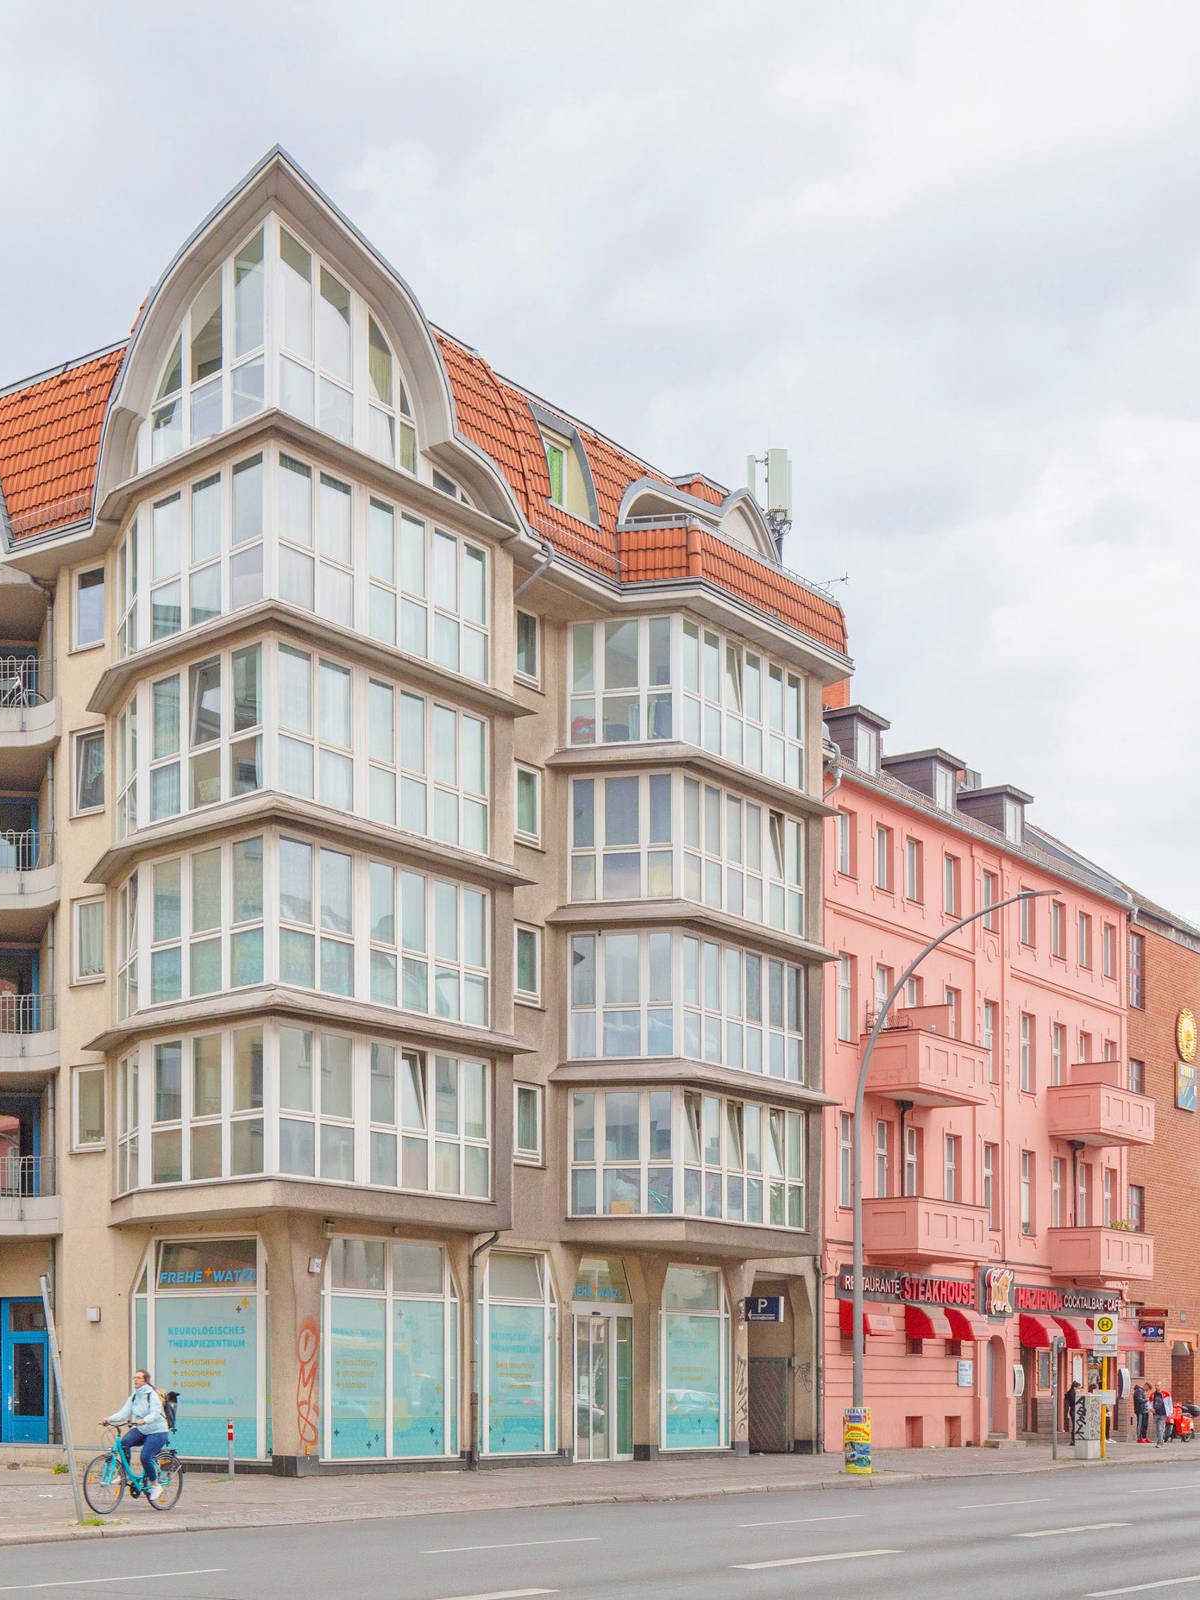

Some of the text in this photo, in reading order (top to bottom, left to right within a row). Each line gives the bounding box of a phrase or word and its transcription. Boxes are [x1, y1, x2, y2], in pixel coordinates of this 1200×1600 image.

[159, 1268, 257, 1284] FREHE WATZL
[843, 1275, 975, 1304] RETAURANTE STEAKHOUSE
[758, 1298, 768, 1313] P
[1014, 1287, 1063, 1312] HAZIENDA
[1064, 1295, 1104, 1310] COCKTAILBAR
[168, 1326, 246, 1336] NEUROLOGISCHES
[1101, 1321, 1109, 1329] H
[1148, 1327, 1155, 1336] P
[168, 1339, 246, 1348] THERAPIEZENTRUM
